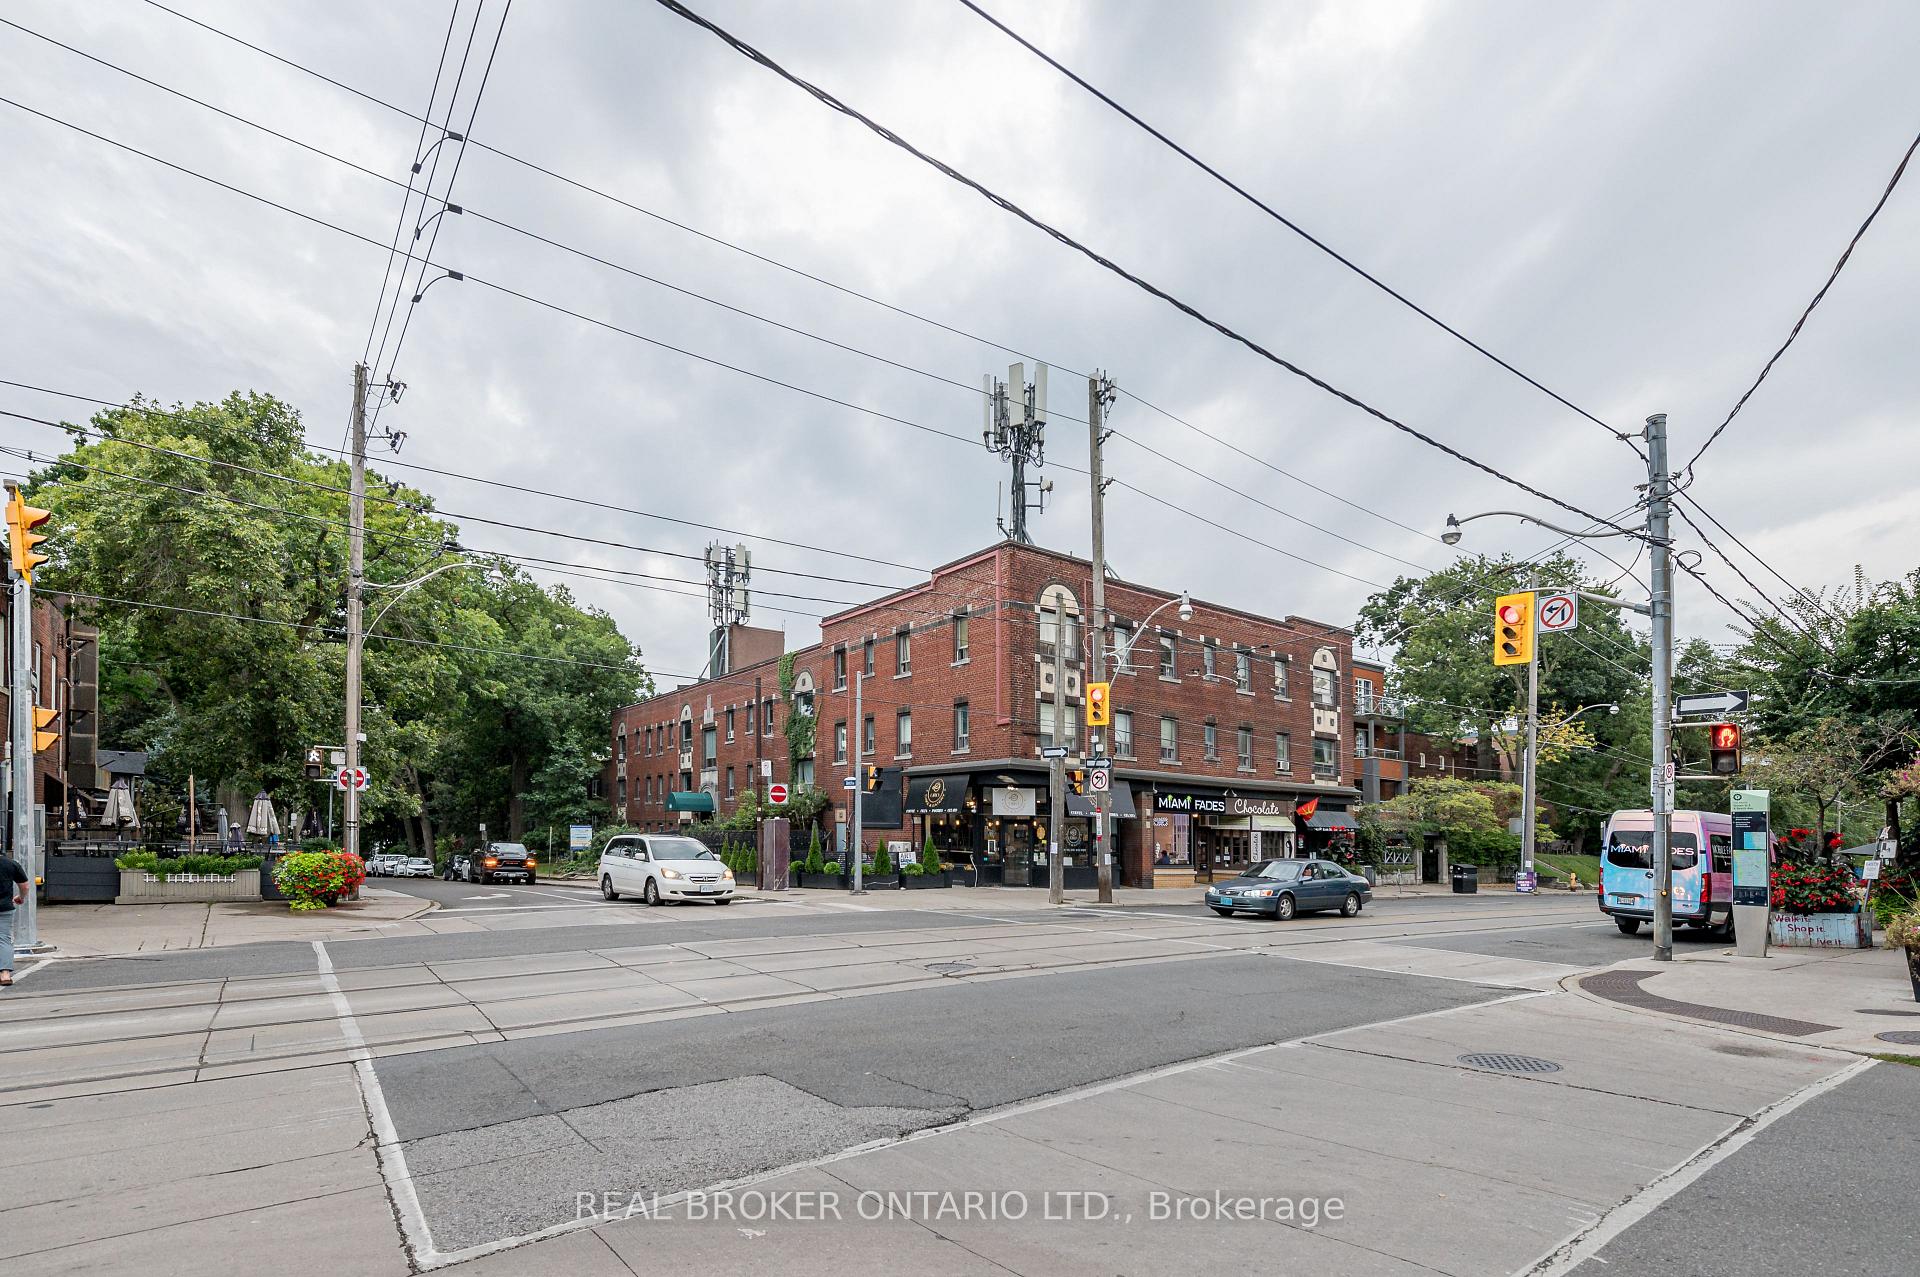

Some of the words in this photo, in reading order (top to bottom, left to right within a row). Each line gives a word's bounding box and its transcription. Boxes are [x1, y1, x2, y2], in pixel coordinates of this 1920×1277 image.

[1158, 796, 1191, 811] MIAMI
[1195, 800, 1226, 812] FADES
[1234, 799, 1280, 816] Chocolate
[1610, 844, 1649, 854] MIAMI
[1775, 914, 1798, 923] Walk
[1787, 924, 1814, 935] Shop
